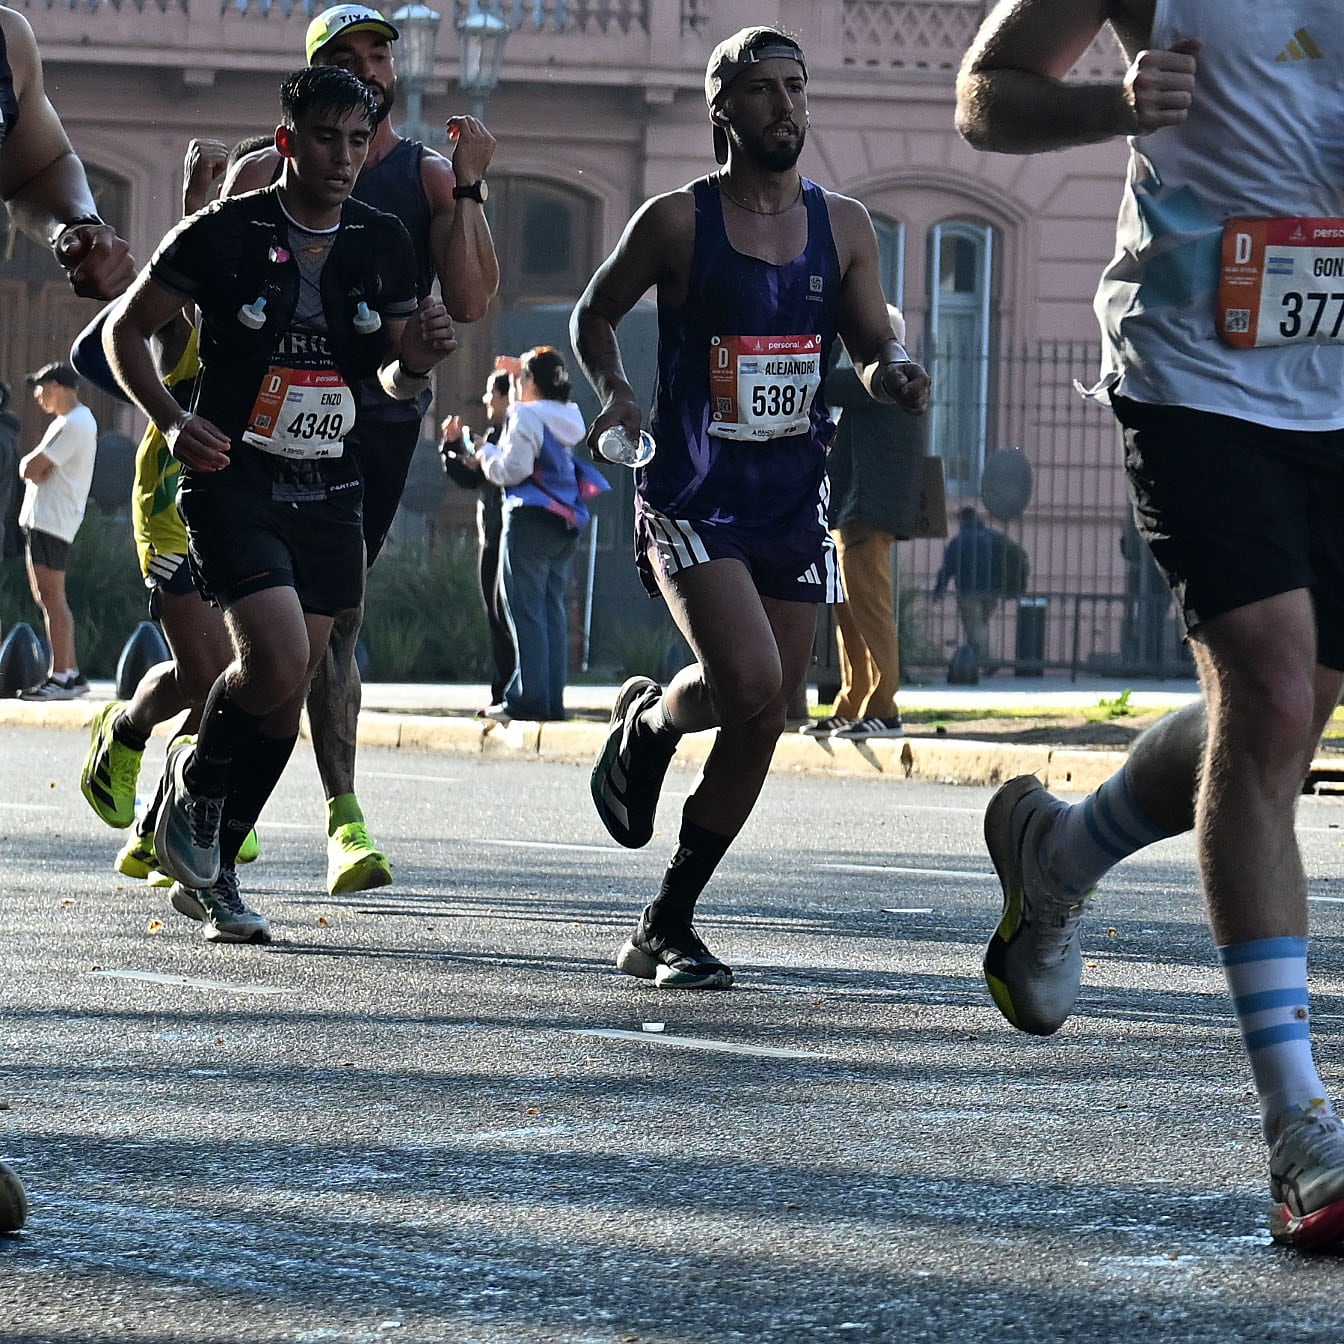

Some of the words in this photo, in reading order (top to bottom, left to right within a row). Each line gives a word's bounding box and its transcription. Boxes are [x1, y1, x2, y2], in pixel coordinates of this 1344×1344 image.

[1235, 233, 1252, 264] D
[768, 341, 800, 350] personal
[718, 348, 729, 368] D
[765, 361, 815, 376] ALEJANDRO
[268, 376, 281, 393] D
[320, 393, 342, 406] ENZO
[751, 384, 808, 417] 5381
[286, 413, 343, 440] 4349
